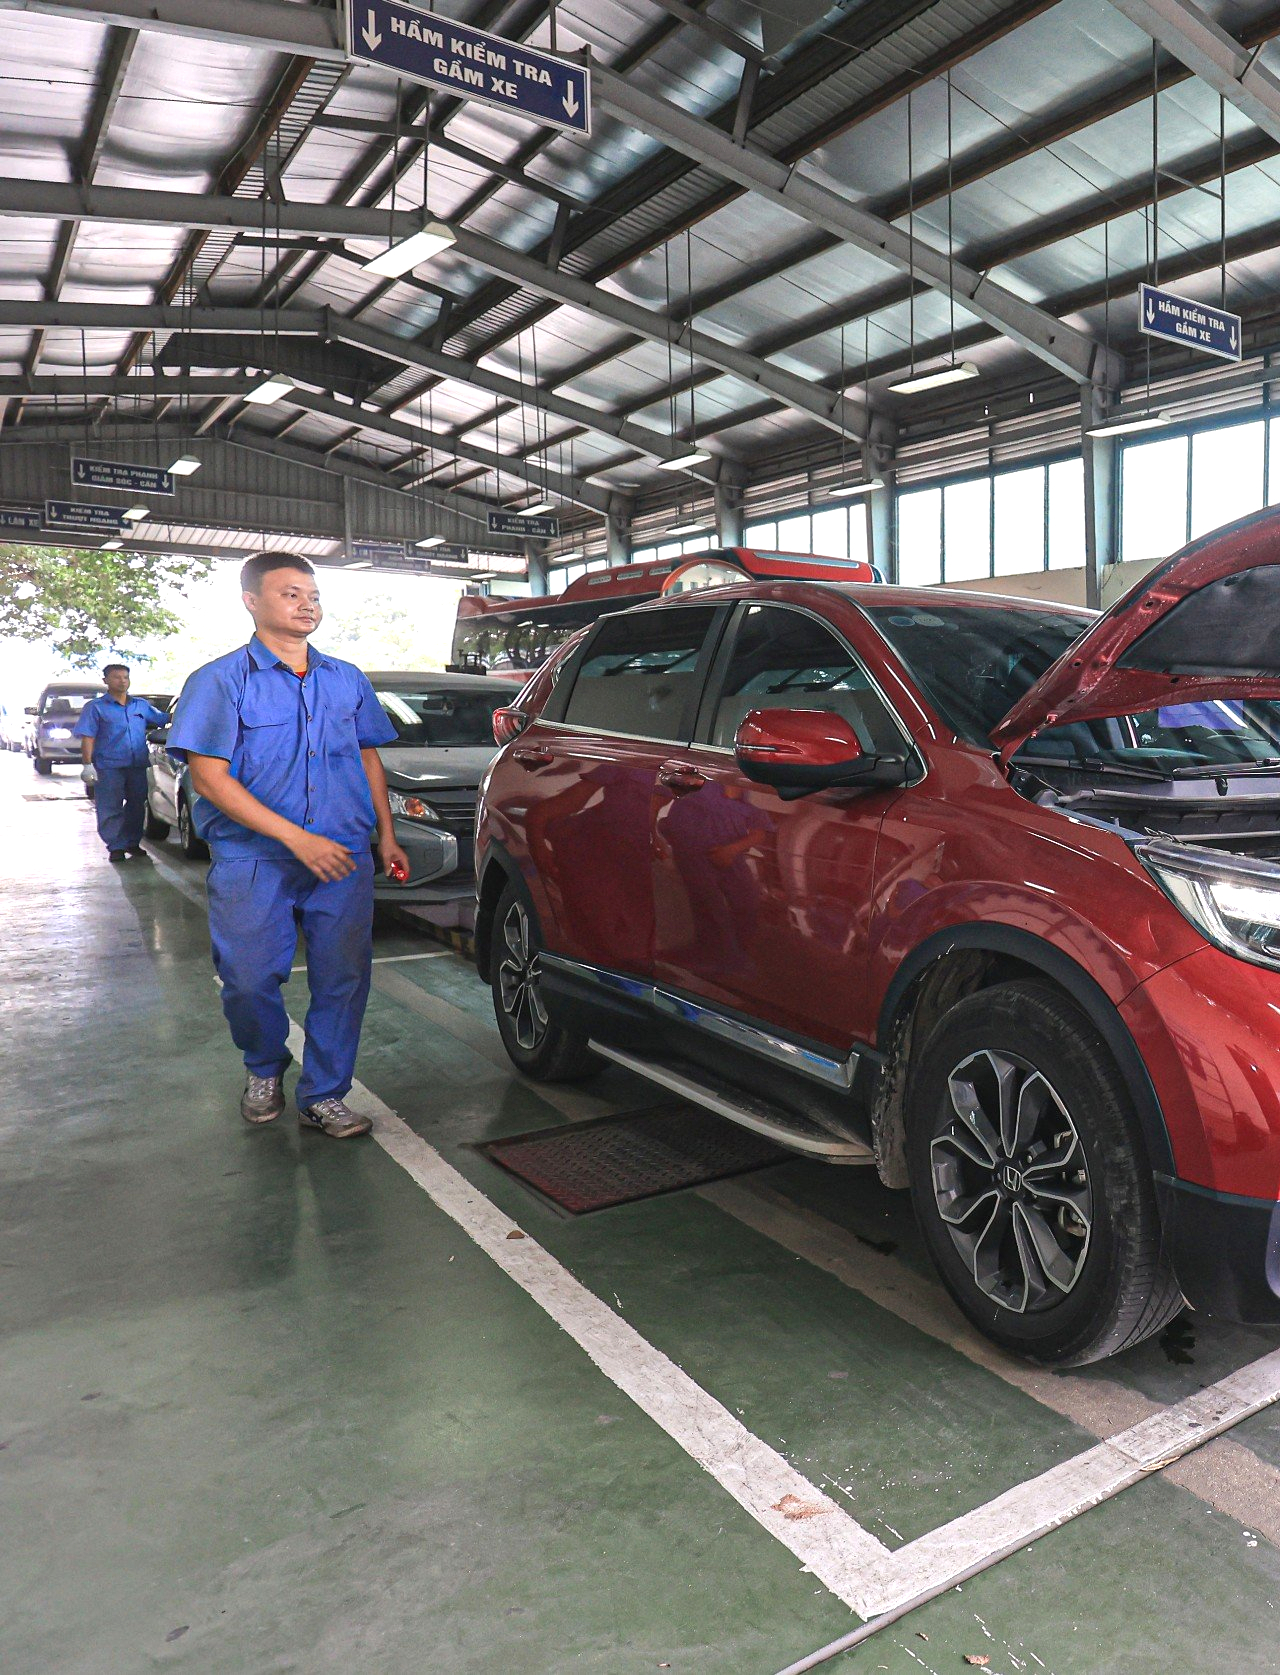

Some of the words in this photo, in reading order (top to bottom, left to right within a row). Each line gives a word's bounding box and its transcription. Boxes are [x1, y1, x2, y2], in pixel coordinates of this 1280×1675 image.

[390, 16, 444, 49] HẦM
[450, 39, 507, 71] KIỂM
[512, 59, 553, 87] TRA
[433, 58, 484, 88] GẦM
[491, 76, 518, 99] XE
[1182, 308, 1206, 326] KIỂM
[1207, 317, 1226, 332] TRA
[1199, 329, 1212, 342] XE
[113, 468, 129, 476] TRA
[130, 470, 158, 479] PHANH
